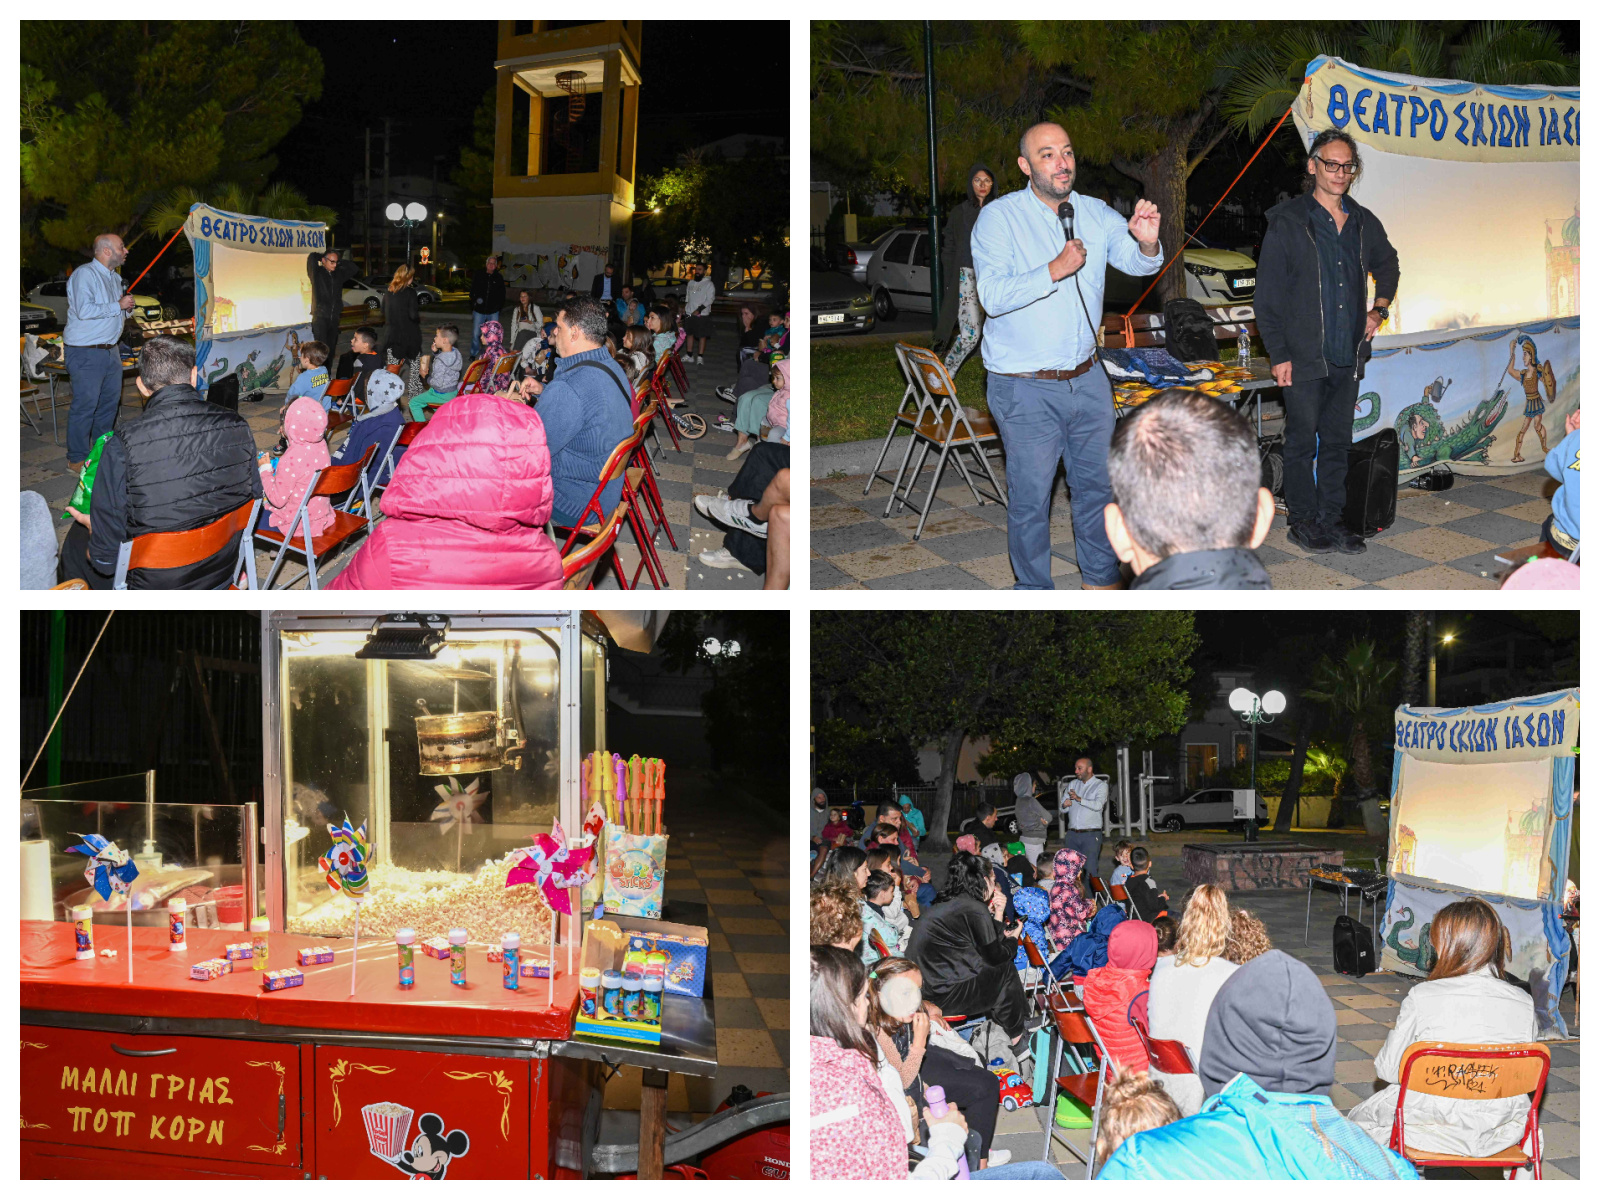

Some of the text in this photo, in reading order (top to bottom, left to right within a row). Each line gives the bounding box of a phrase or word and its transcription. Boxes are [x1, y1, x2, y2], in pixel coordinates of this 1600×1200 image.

[1327, 84, 1580, 147] ΘΕΑΤΡΟ ΣΚΙΩΝ ΙΑΣ
[201, 216, 325, 248] ΘΕΑΤΡΟ ΣΚΙΩΝ ΙΑΣΩΝ
[1397, 720, 1447, 750] ΘΕΑΤΡΟ
[1504, 709, 1566, 749] ΙΑΣΩΝ
[620, 876, 653, 889] STICKS
[61, 1066, 234, 1105] ΜΑΛΛΙ ΓΡΙΑΣ
[67, 1106, 225, 1145] ΠΟΠ ΚΟΡΝ
